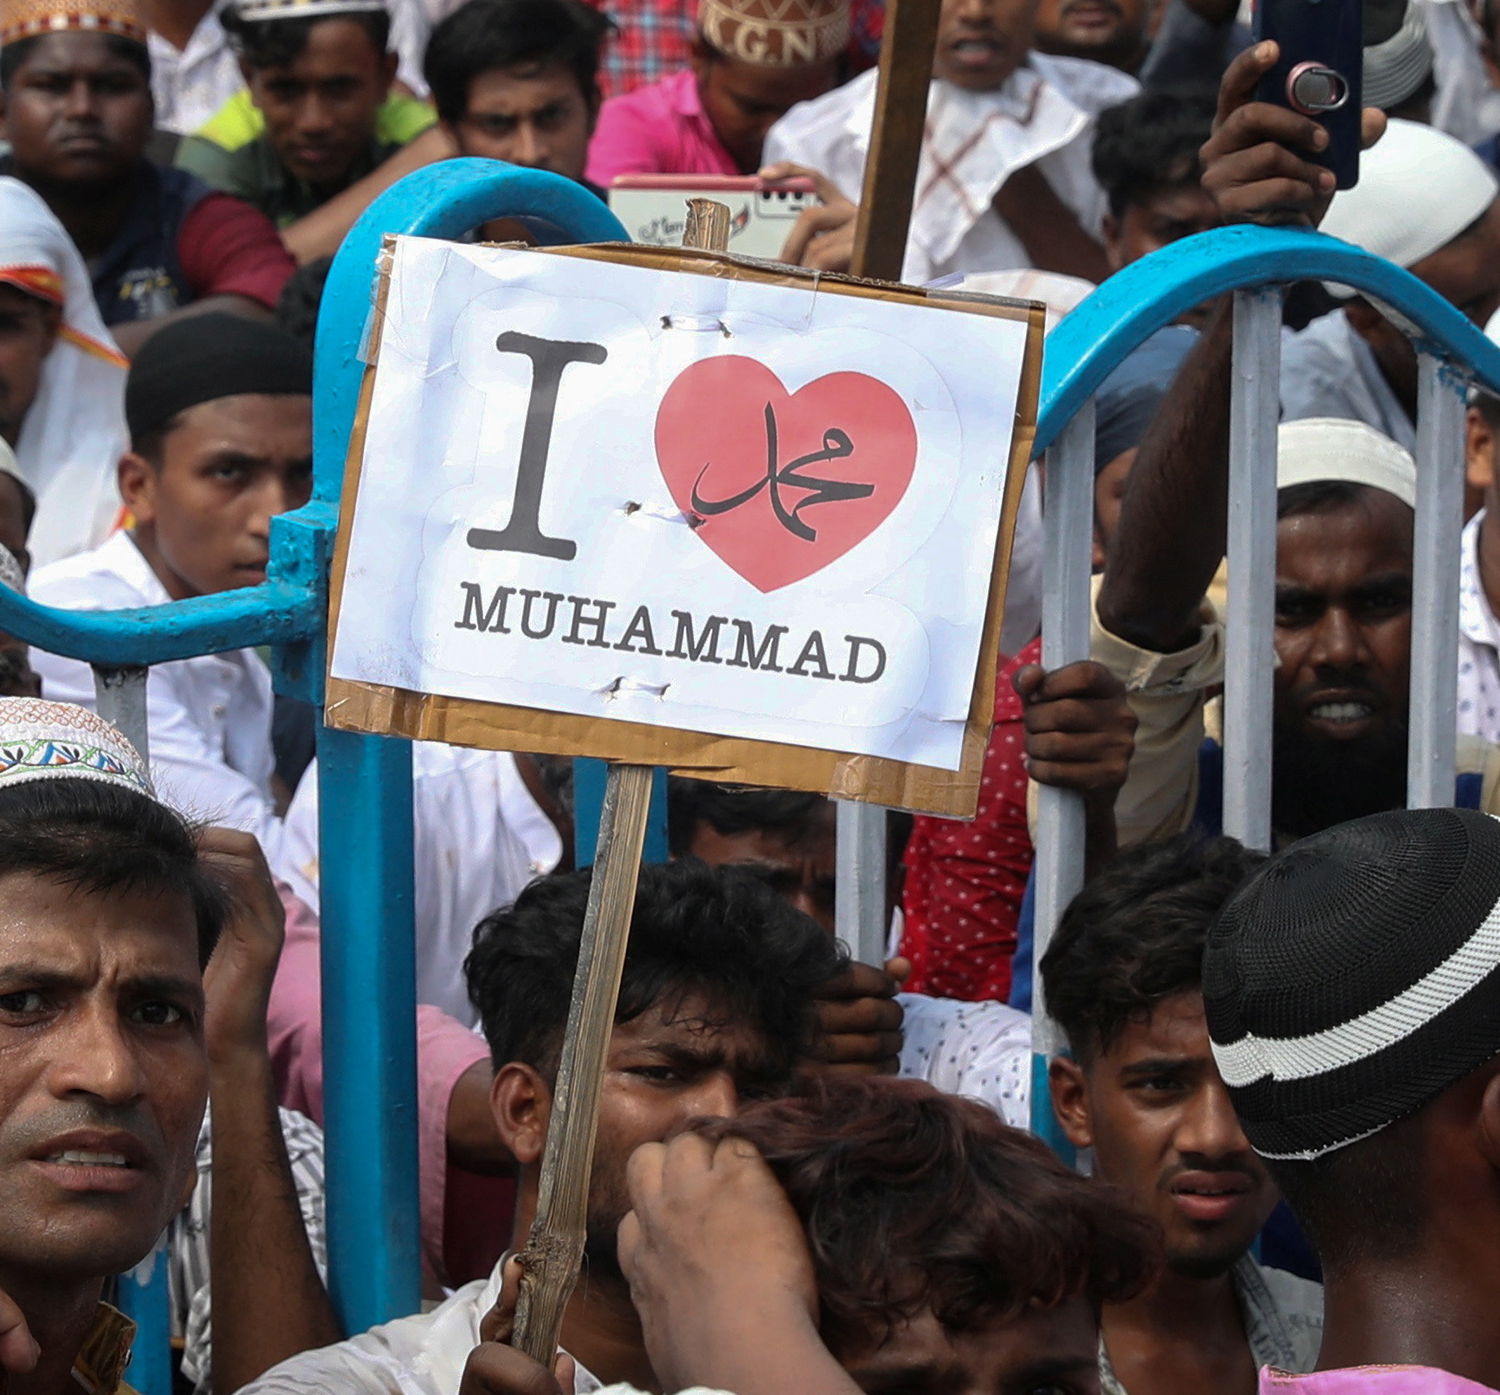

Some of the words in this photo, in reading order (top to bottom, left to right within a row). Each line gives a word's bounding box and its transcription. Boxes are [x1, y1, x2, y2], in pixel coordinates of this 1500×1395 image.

[467, 331, 608, 561] I
[691, 401, 875, 542] محمد
[454, 582, 887, 685] MUHAMMAD
